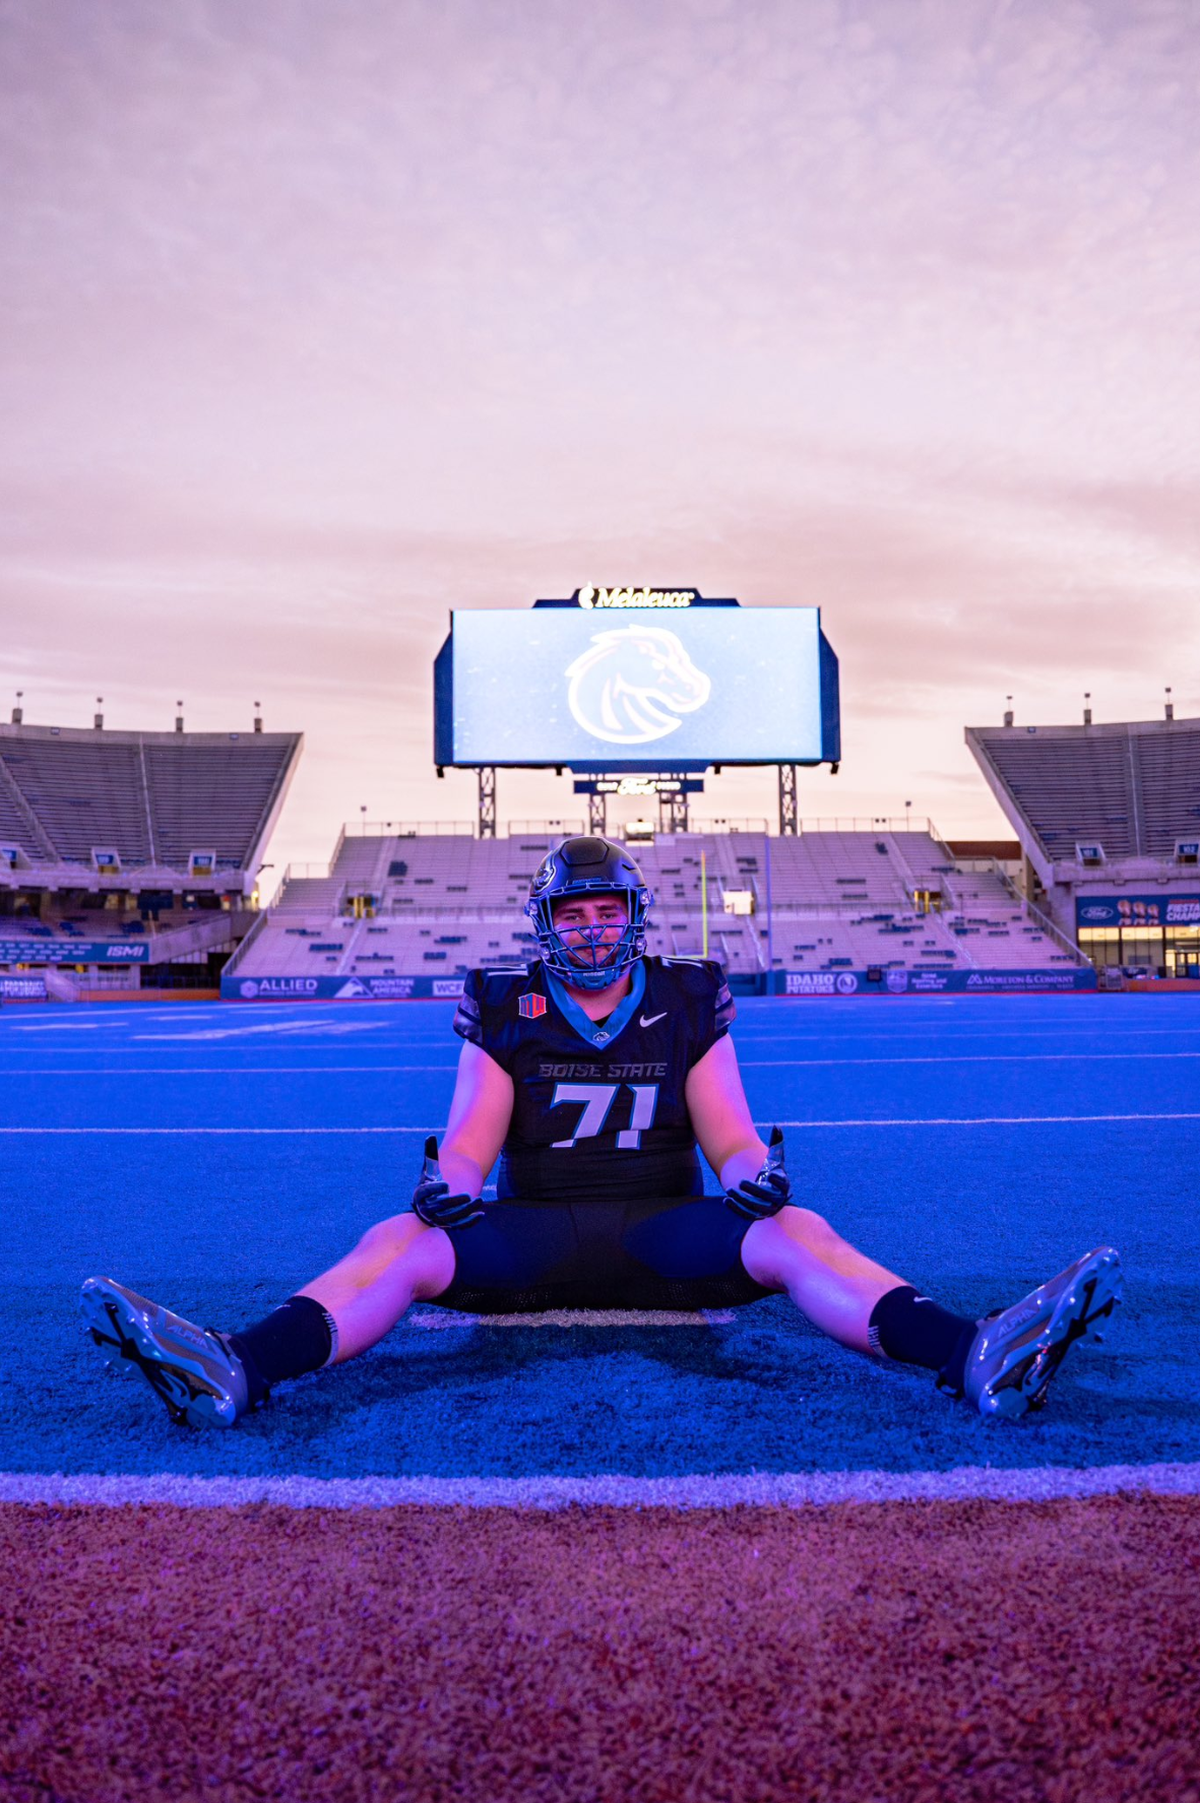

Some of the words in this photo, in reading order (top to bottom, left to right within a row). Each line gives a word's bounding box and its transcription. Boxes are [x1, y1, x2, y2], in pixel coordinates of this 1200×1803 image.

[595, 586, 690, 608] Melaleuca
[617, 778, 656, 796] Ford
[107, 945, 145, 957] ISMI
[259, 979, 318, 991] ALLIED
[370, 979, 414, 987] MOUNTAIN
[786, 974, 834, 985] IDAHO
[1025, 975, 1033, 984] &
[1034, 974, 1074, 984] COMPANY
[538, 1063, 603, 1078] BOISE
[607, 1062, 668, 1078] STATE
[549, 1082, 660, 1150] 71
[998, 1308, 1036, 1338] ALPHA
[167, 1325, 208, 1349] ALPHA
